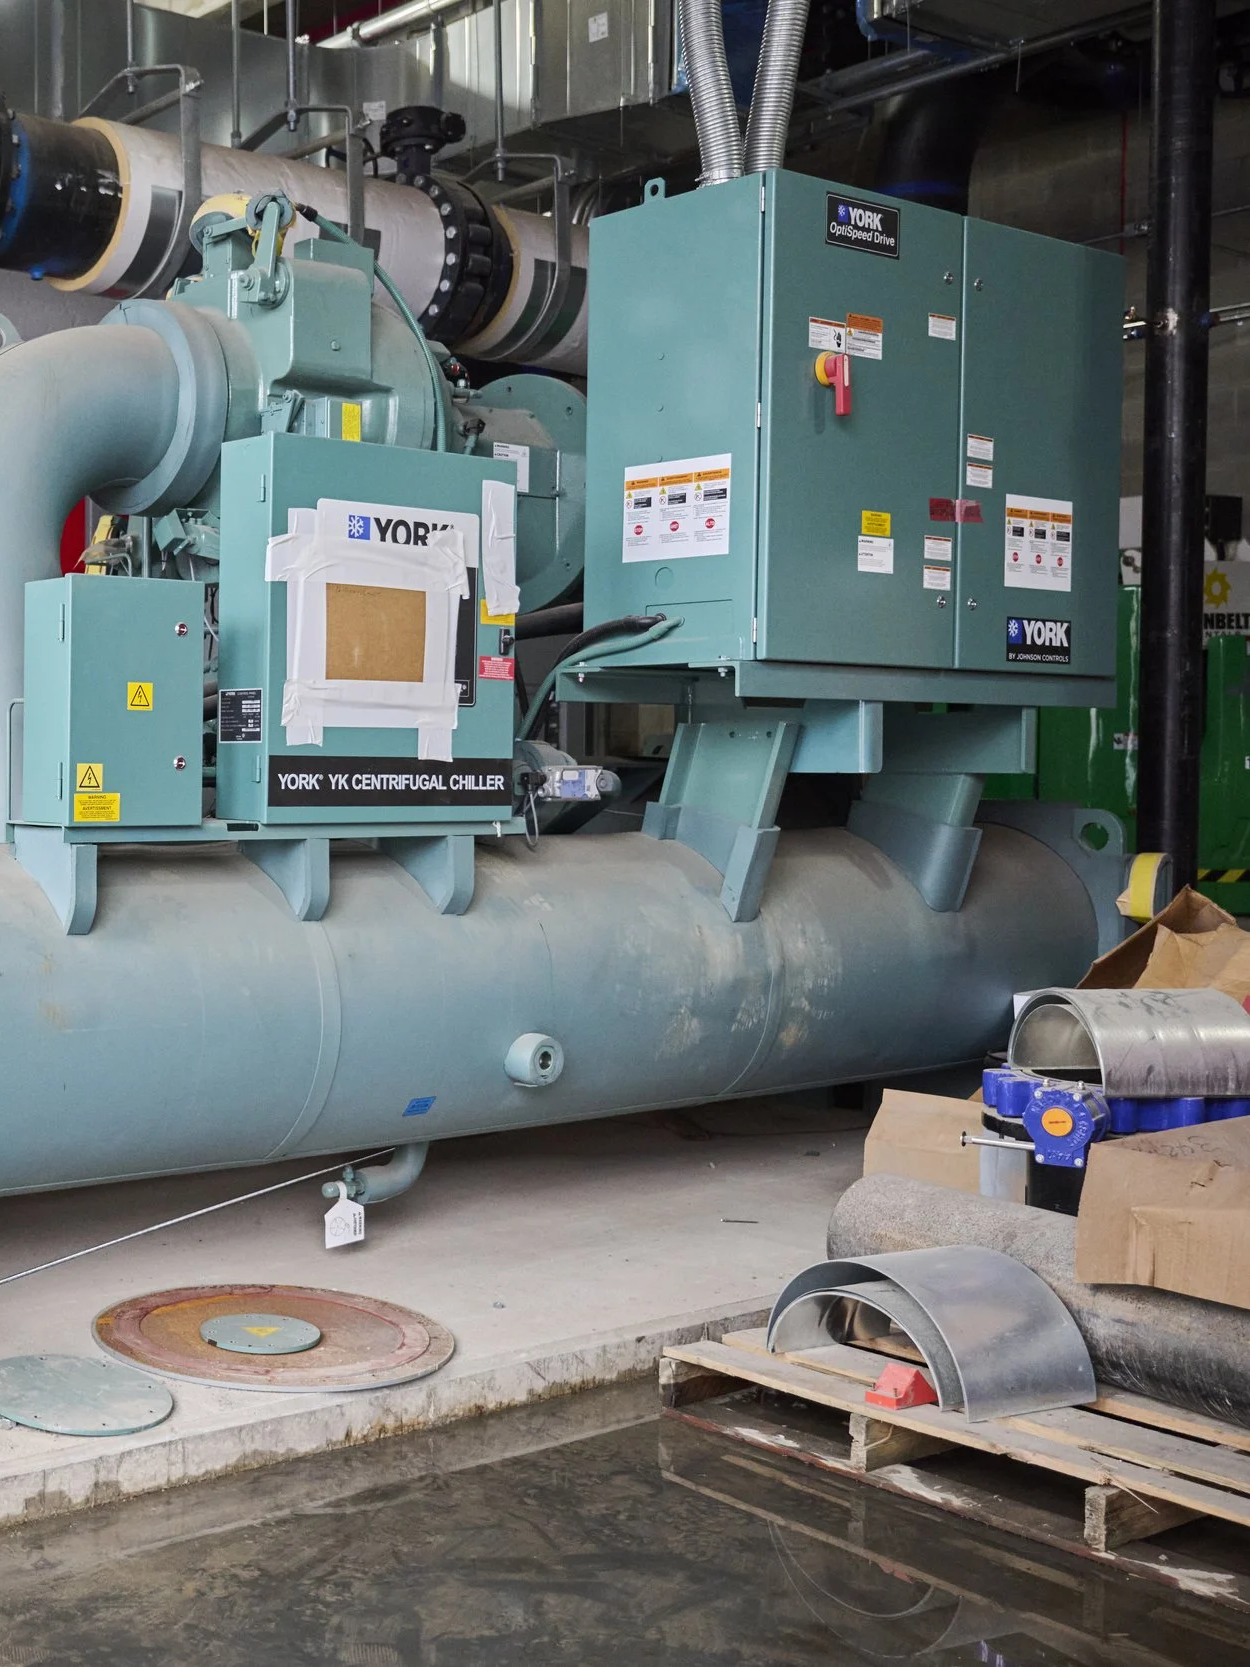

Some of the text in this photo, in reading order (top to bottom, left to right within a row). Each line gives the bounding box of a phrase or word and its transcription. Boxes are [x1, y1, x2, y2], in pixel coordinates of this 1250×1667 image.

[848, 206, 883, 231] YORK
[830, 222, 895, 246] OptiSpeed Drive
[1203, 613, 1250, 630] NBELT
[1022, 619, 1069, 647] YORK
[1008, 652, 1069, 663] BY JOHNSON CONTROLS
[328, 774, 350, 790] YK
[352, 774, 447, 790] CENTRIFUGAL
[450, 774, 504, 790] CHILLER
